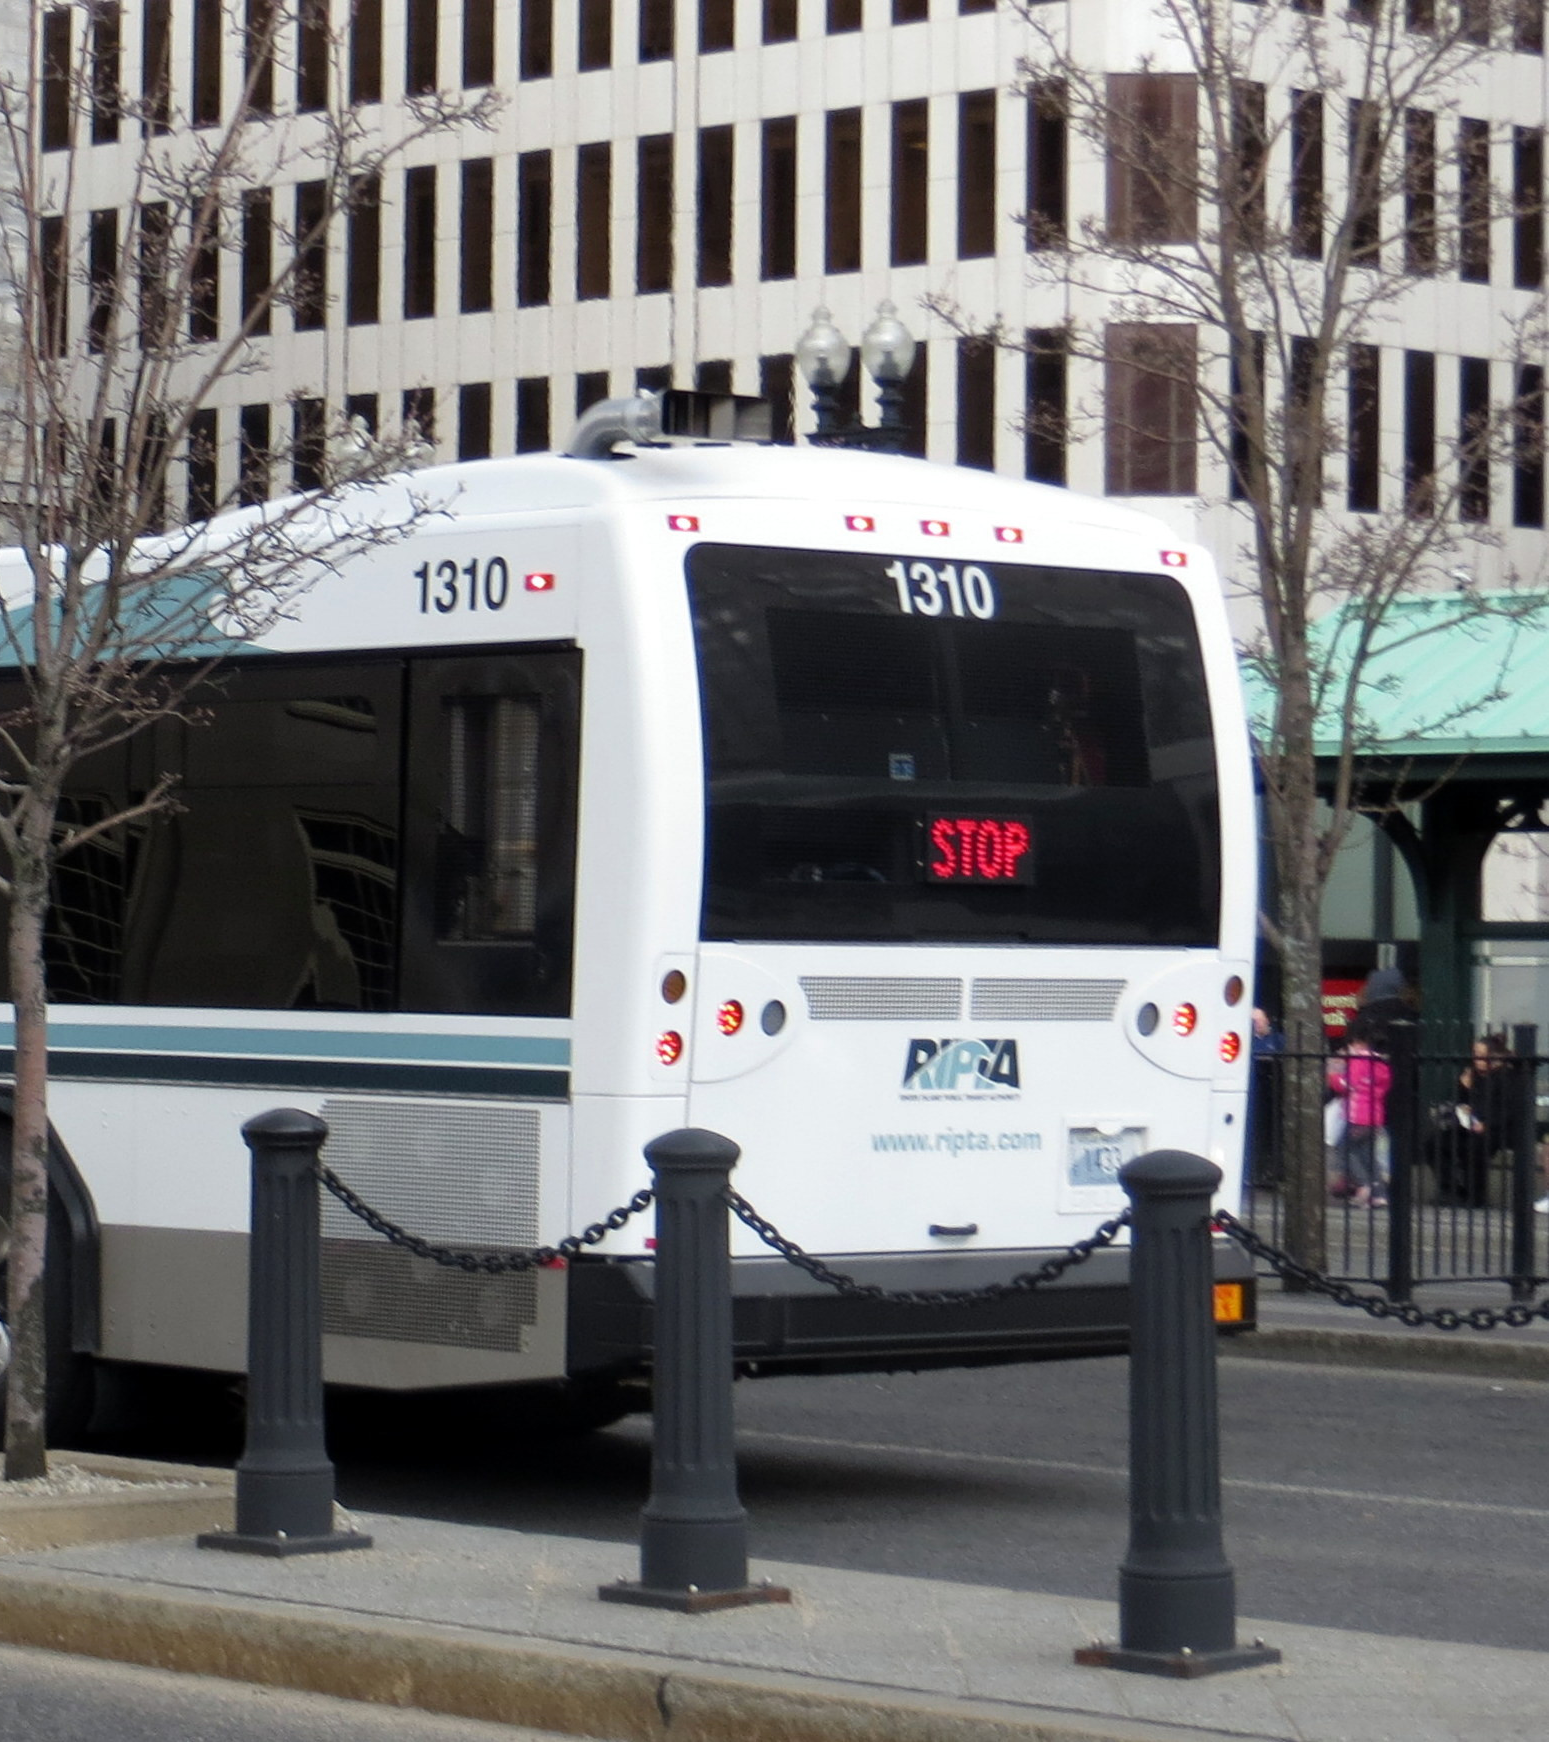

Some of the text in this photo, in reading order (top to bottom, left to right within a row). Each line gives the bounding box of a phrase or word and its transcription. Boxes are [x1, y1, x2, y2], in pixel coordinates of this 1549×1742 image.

[413, 556, 509, 614] 1310
[884, 560, 995, 620] 1310
[931, 818, 1030, 879] STOP
[902, 1038, 1021, 1090] RIPTA
[871, 1127, 1042, 1158] www.ripta.com
